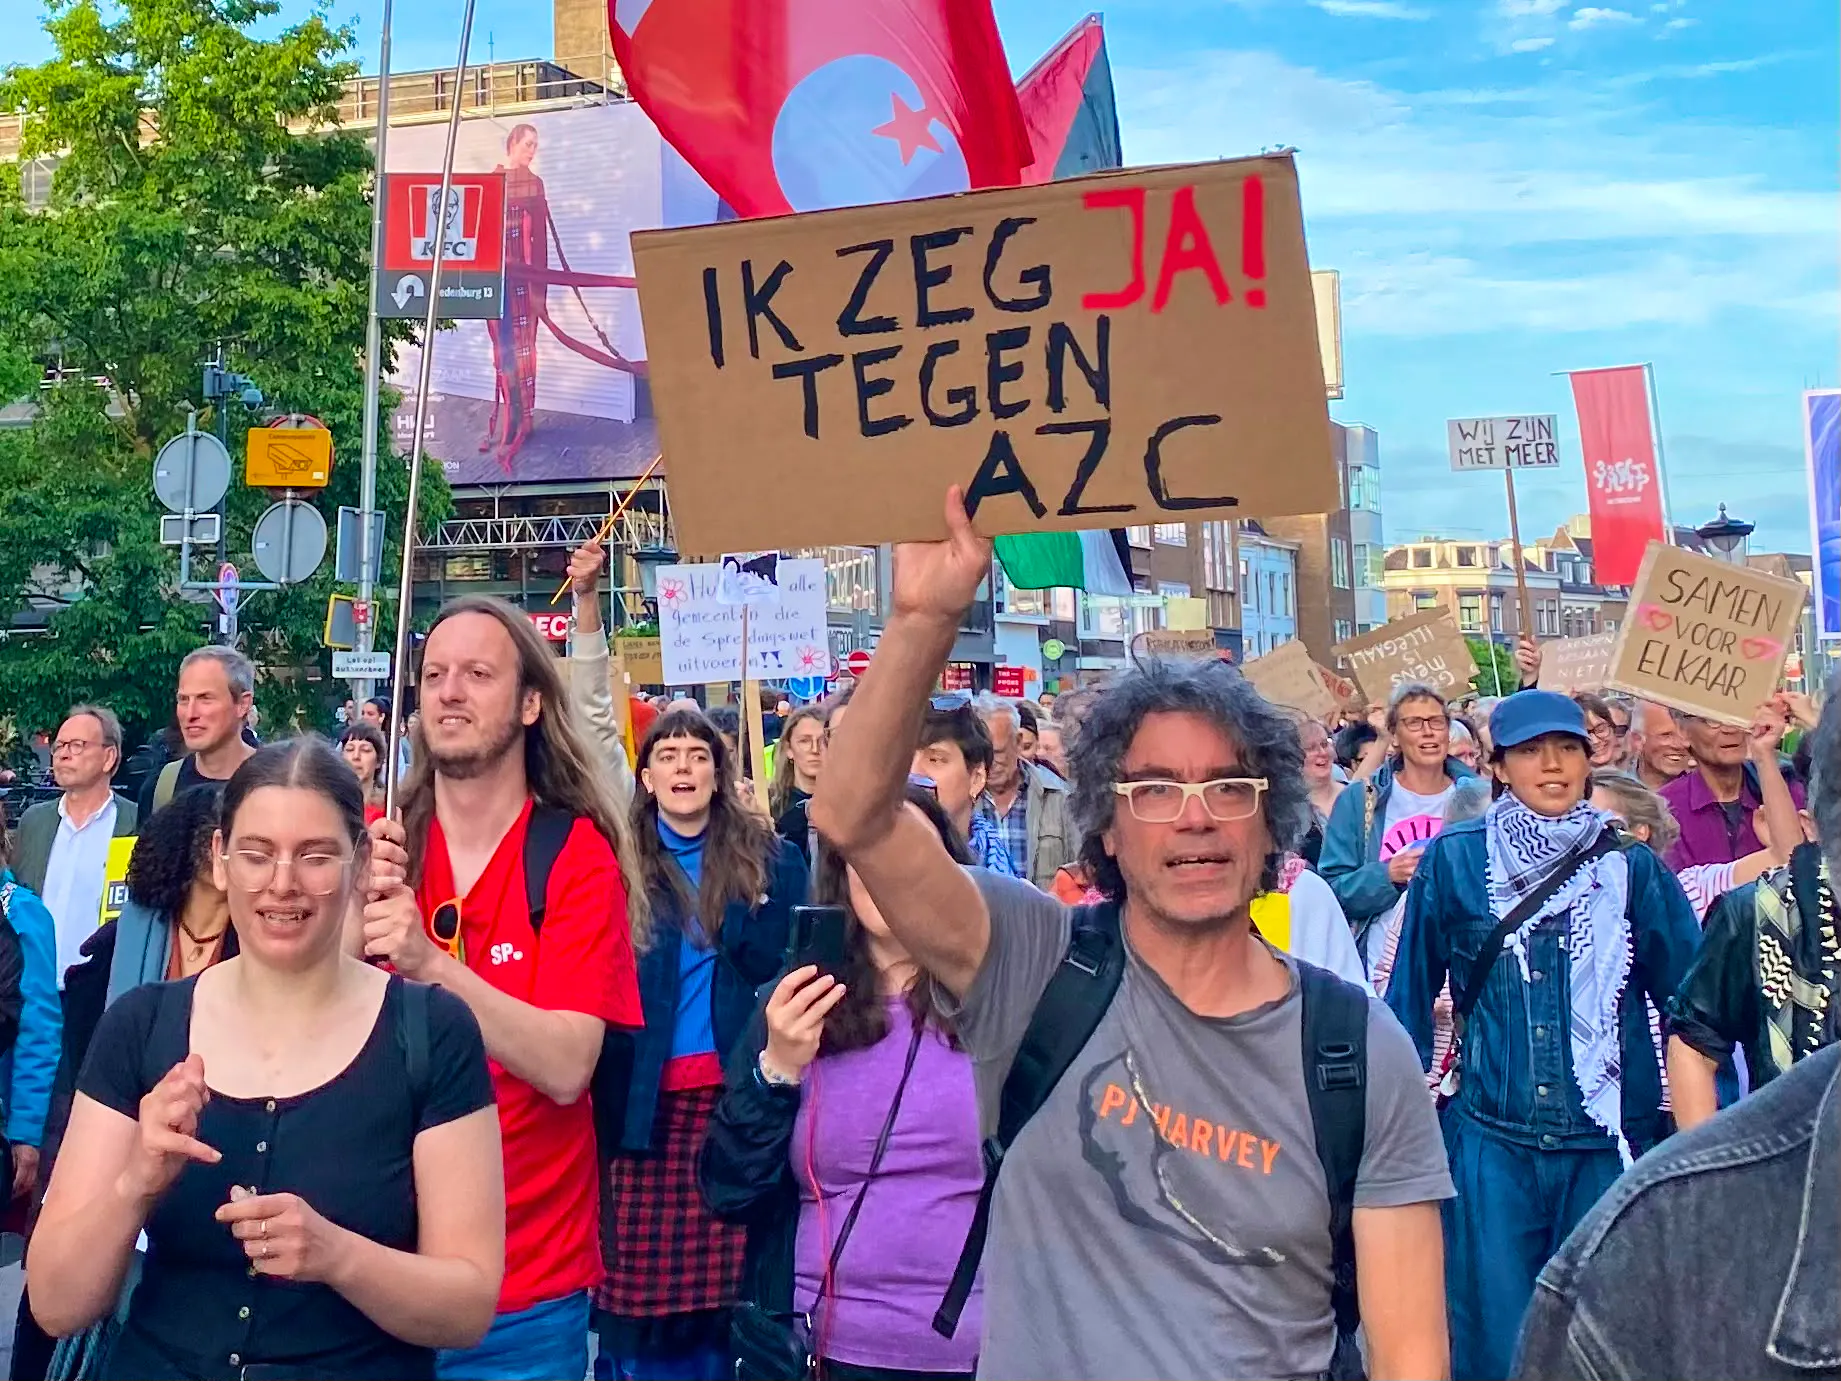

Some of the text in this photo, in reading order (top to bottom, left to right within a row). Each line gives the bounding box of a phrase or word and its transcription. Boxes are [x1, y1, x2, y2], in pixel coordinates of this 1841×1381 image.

[421, 241, 467, 256] KFC
[703, 174, 1266, 369] IK ZEG JA!
[439, 286, 493, 300] edenburg 13
[773, 314, 1111, 439] TEGEN
[965, 414, 1238, 520] AZC
[1458, 442, 1558, 466] MET MEER
[788, 574, 817, 592] alle
[774, 605, 800, 621] die
[1660, 569, 1782, 632] SAMEN
[673, 634, 692, 648] de
[1675, 615, 1737, 655] VOOR
[1402, 648, 1422, 665] IS
[1636, 639, 1747, 700] ELKAAR
[1099, 1083, 1281, 1174] PJ HARVEY
